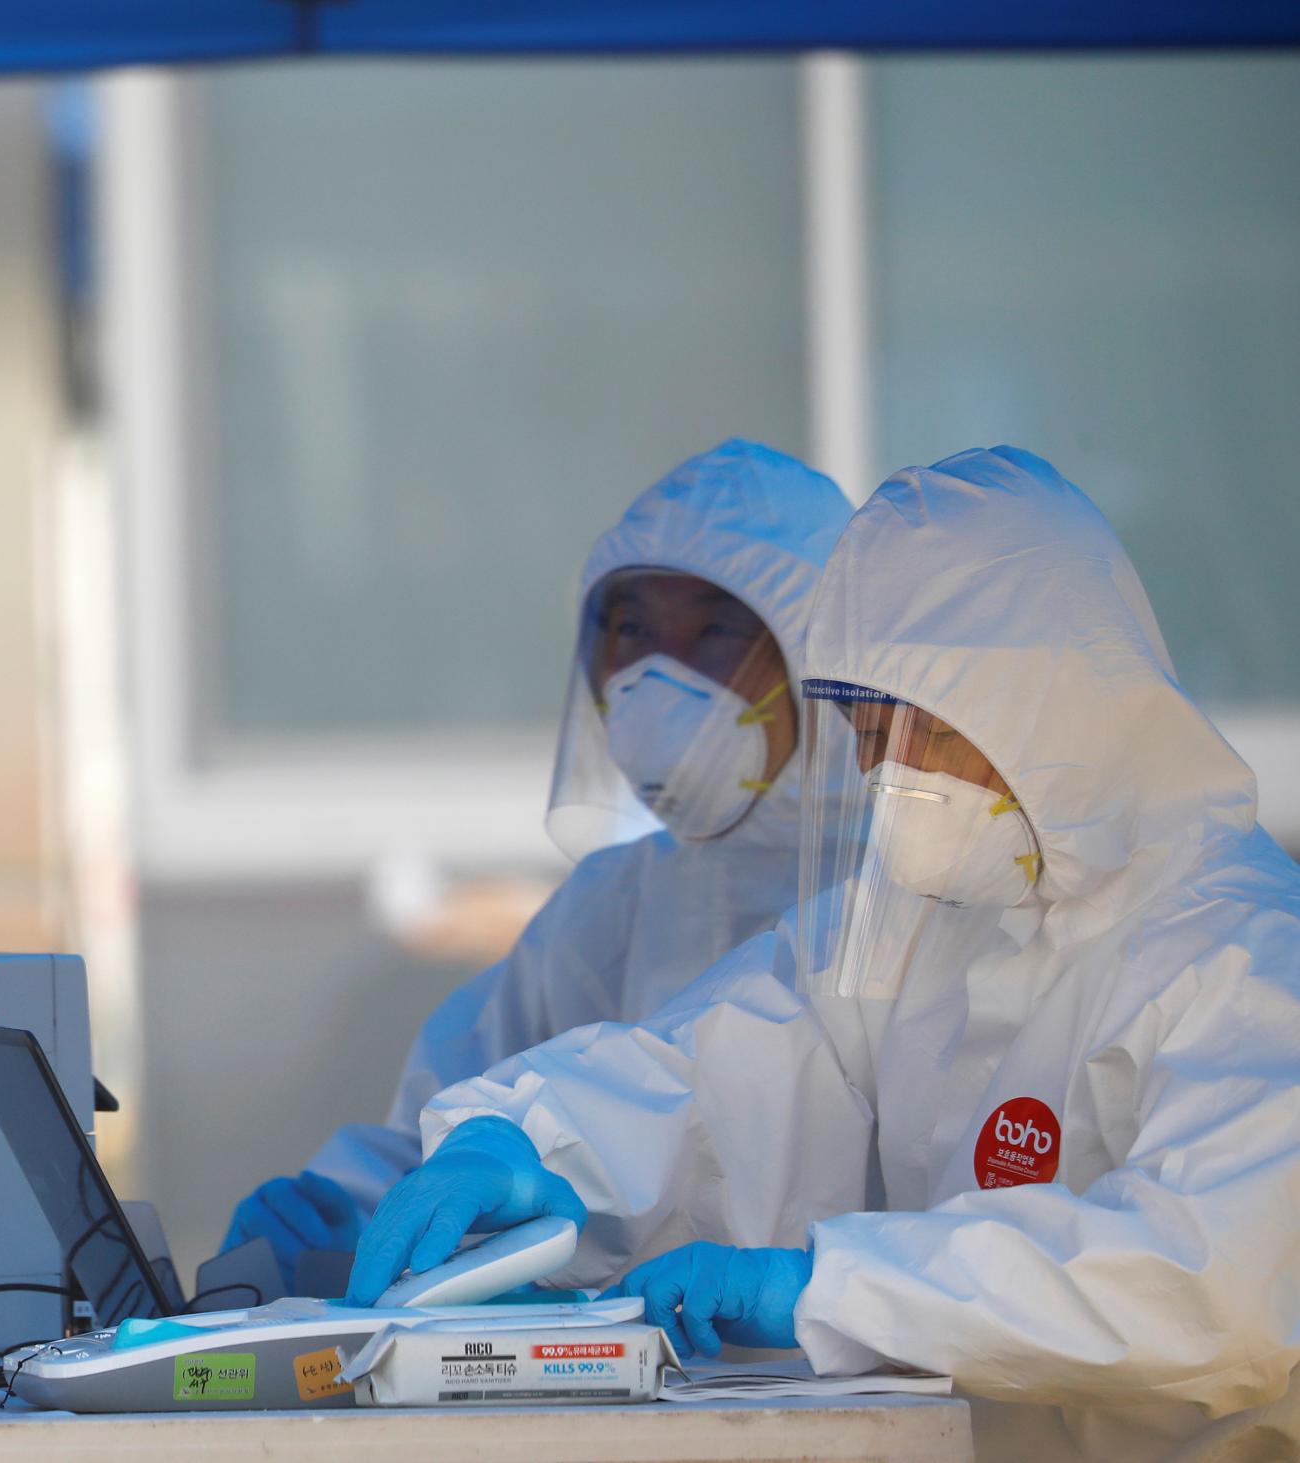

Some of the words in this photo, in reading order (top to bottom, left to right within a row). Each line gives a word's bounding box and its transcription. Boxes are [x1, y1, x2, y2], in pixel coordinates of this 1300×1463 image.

[806, 684, 840, 696] Protective
[842, 686, 886, 700] isolation
[995, 1111, 1053, 1154] boho
[464, 1342, 493, 1355] RICO
[541, 1346, 573, 1357] 99.9%
[218, 1368, 249, 1379] 선관위
[544, 1363, 575, 1374] KILLS
[578, 1362, 616, 1374] 99.9%
